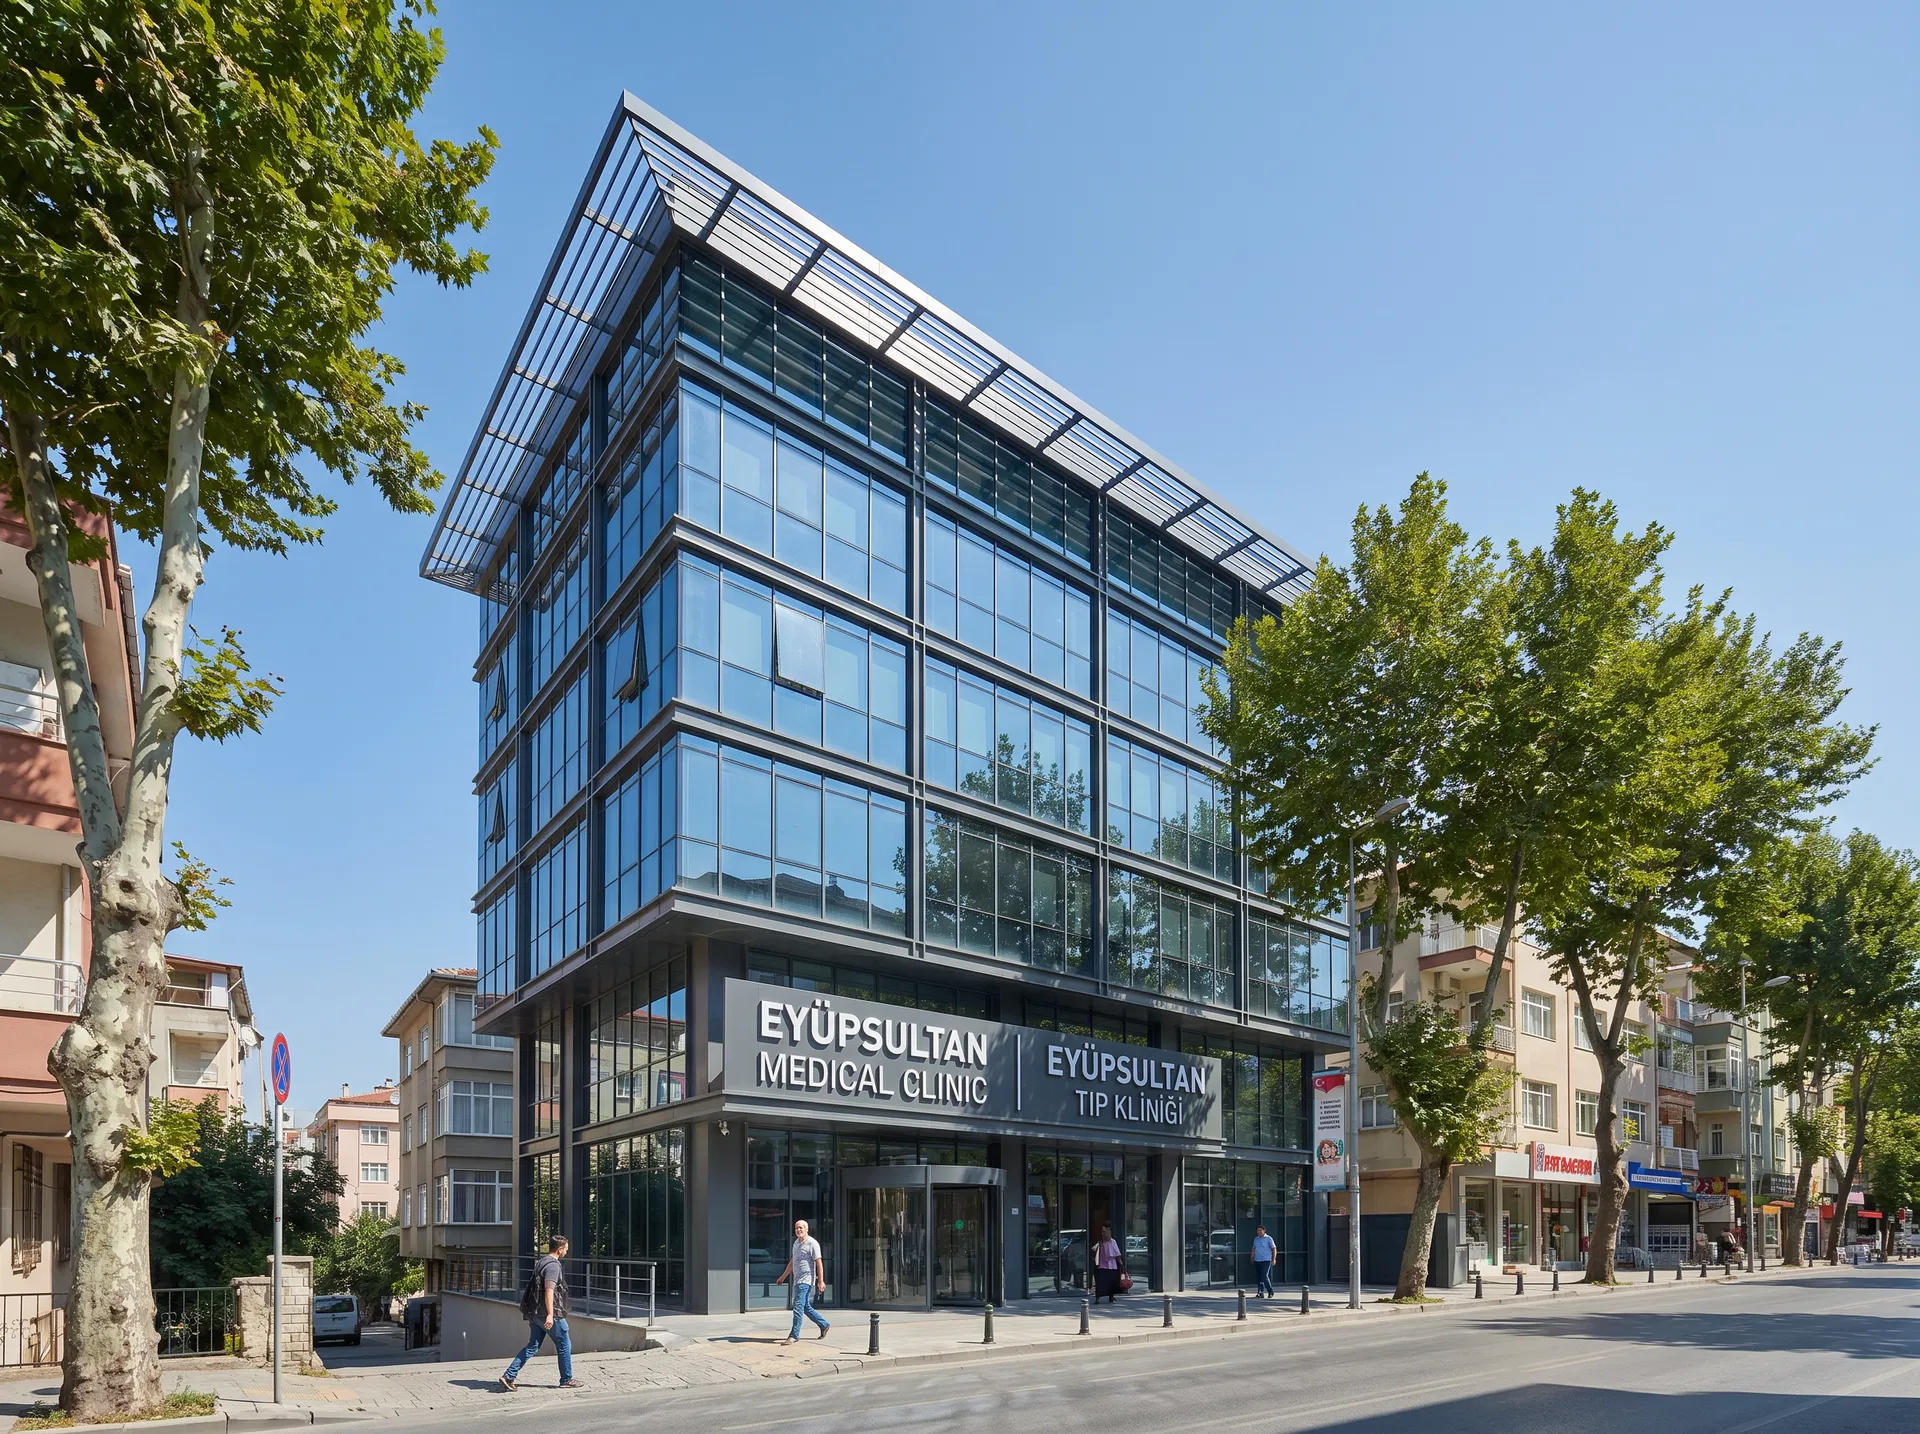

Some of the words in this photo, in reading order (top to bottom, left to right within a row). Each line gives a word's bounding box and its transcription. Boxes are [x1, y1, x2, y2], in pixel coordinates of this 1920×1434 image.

[759, 998, 988, 1067] EYÜPSULTAN
[759, 1050, 895, 1096] MEDICAL
[902, 1068, 988, 1105] CLINIC
[1047, 1042, 1206, 1095] EYÜPSULTAN
[1075, 1089, 1109, 1117] TIP
[1114, 1091, 1184, 1126] KLİNİĞİ
